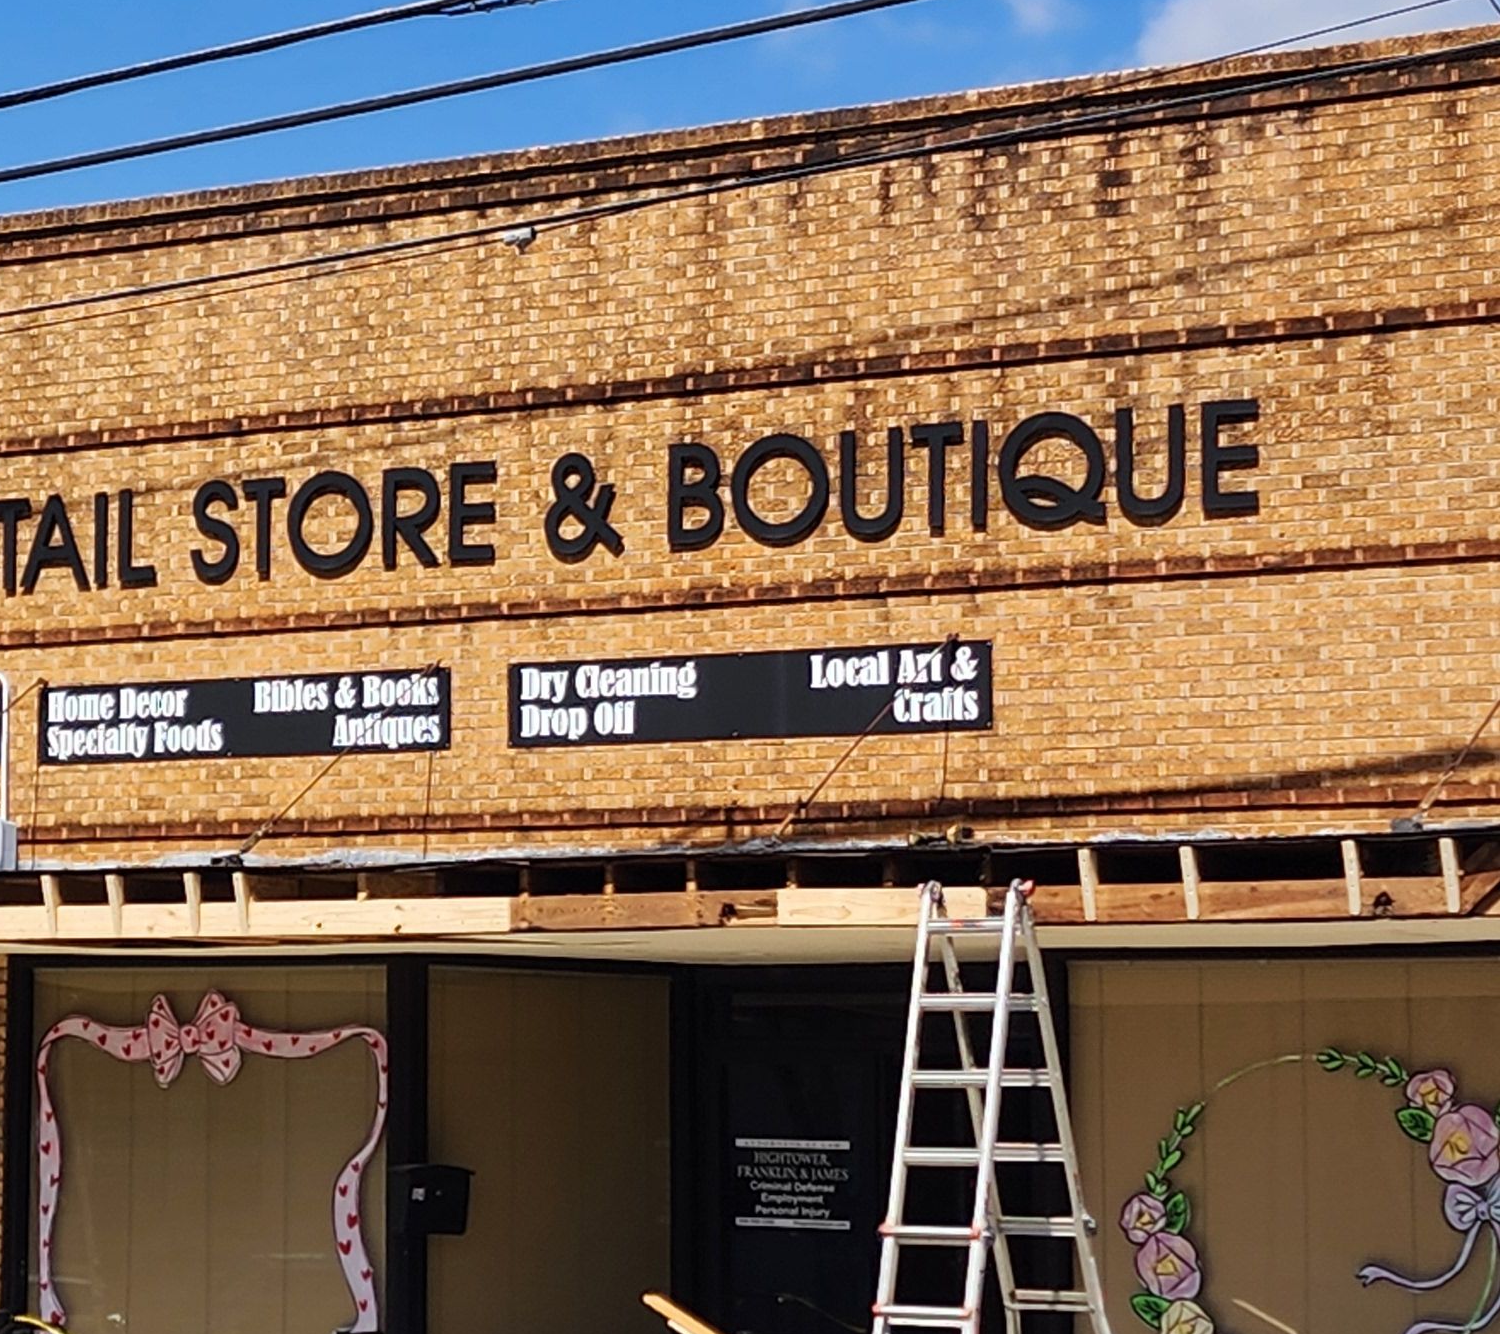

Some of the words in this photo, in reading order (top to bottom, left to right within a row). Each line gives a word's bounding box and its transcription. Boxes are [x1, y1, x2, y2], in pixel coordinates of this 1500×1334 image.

[190, 460, 498, 587] STORE
[544, 452, 624, 564] &
[668, 399, 1259, 553] BOUTIQUE
[520, 667, 567, 702] Dry
[574, 661, 698, 699] Cleaning
[810, 649, 889, 690] Local
[897, 648, 943, 684] Art
[949, 646, 978, 682] &
[47, 691, 116, 724] Home
[119, 687, 189, 720] Decor
[253, 677, 329, 713] Bibles
[334, 675, 357, 708] &
[361, 672, 440, 706] Books
[892, 686, 979, 723] Crafts
[46, 724, 150, 759] Specialty
[152, 720, 223, 754] Foods
[332, 713, 442, 748] Antiques
[519, 703, 588, 741] Drop
[593, 701, 637, 735] Off
[749, 1180, 792, 1193] Criminal
[794, 1182, 836, 1193] Defense
[811, 1168, 850, 1182] JAMES
[754, 1204, 800, 1217] Personal
[801, 1206, 831, 1220] Injury
[760, 1192, 825, 1206] Employment
